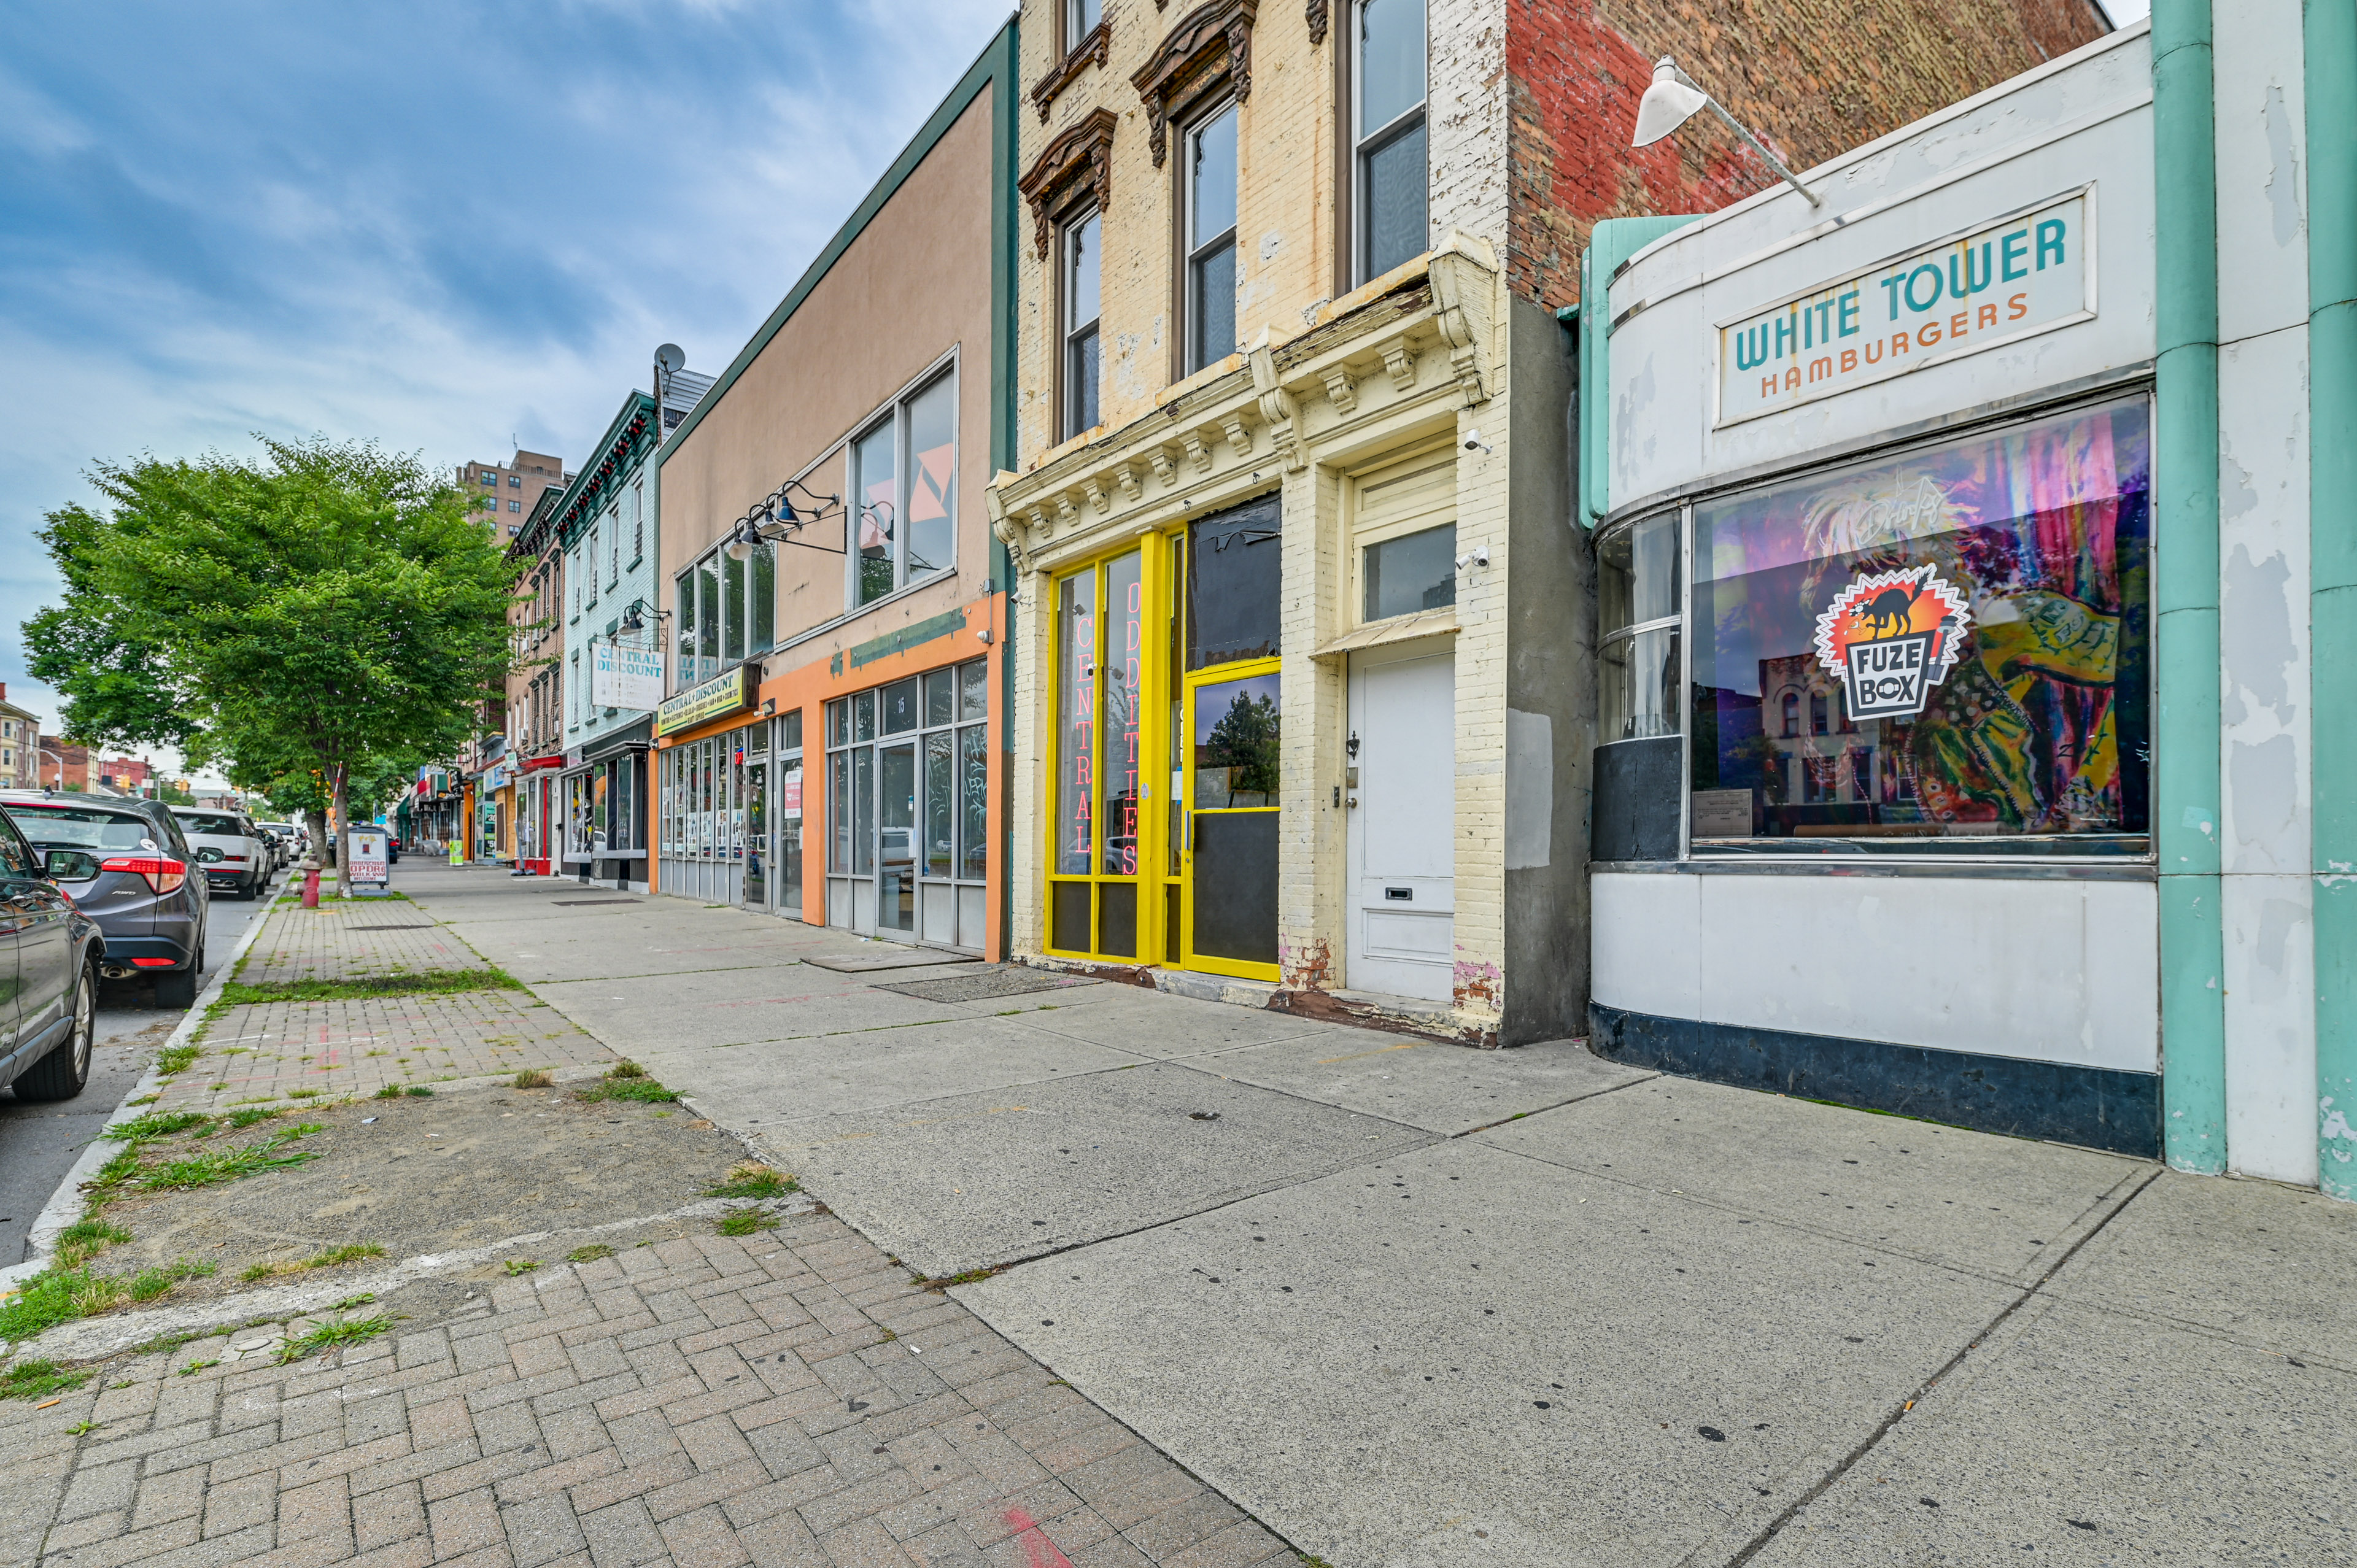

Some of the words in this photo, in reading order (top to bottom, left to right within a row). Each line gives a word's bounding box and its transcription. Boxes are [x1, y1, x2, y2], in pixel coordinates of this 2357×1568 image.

[1736, 289, 1860, 371] WHITE
[1881, 218, 2066, 322] TOWER
[1762, 293, 2027, 398] HAMBURGERS
[597, 660, 662, 678] DISCOUNT
[1857, 642, 1922, 674] FUZE
[664, 693, 692, 715] CENTRAL
[696, 674, 733, 702] DISCOUNT
[725, 688, 738, 700] COSMETICS
[897, 697, 905, 714] 15
[1860, 674, 1916, 705] BOX
[1075, 617, 1093, 853] CENTRAL
[1123, 582, 1140, 875] ODDITIES
